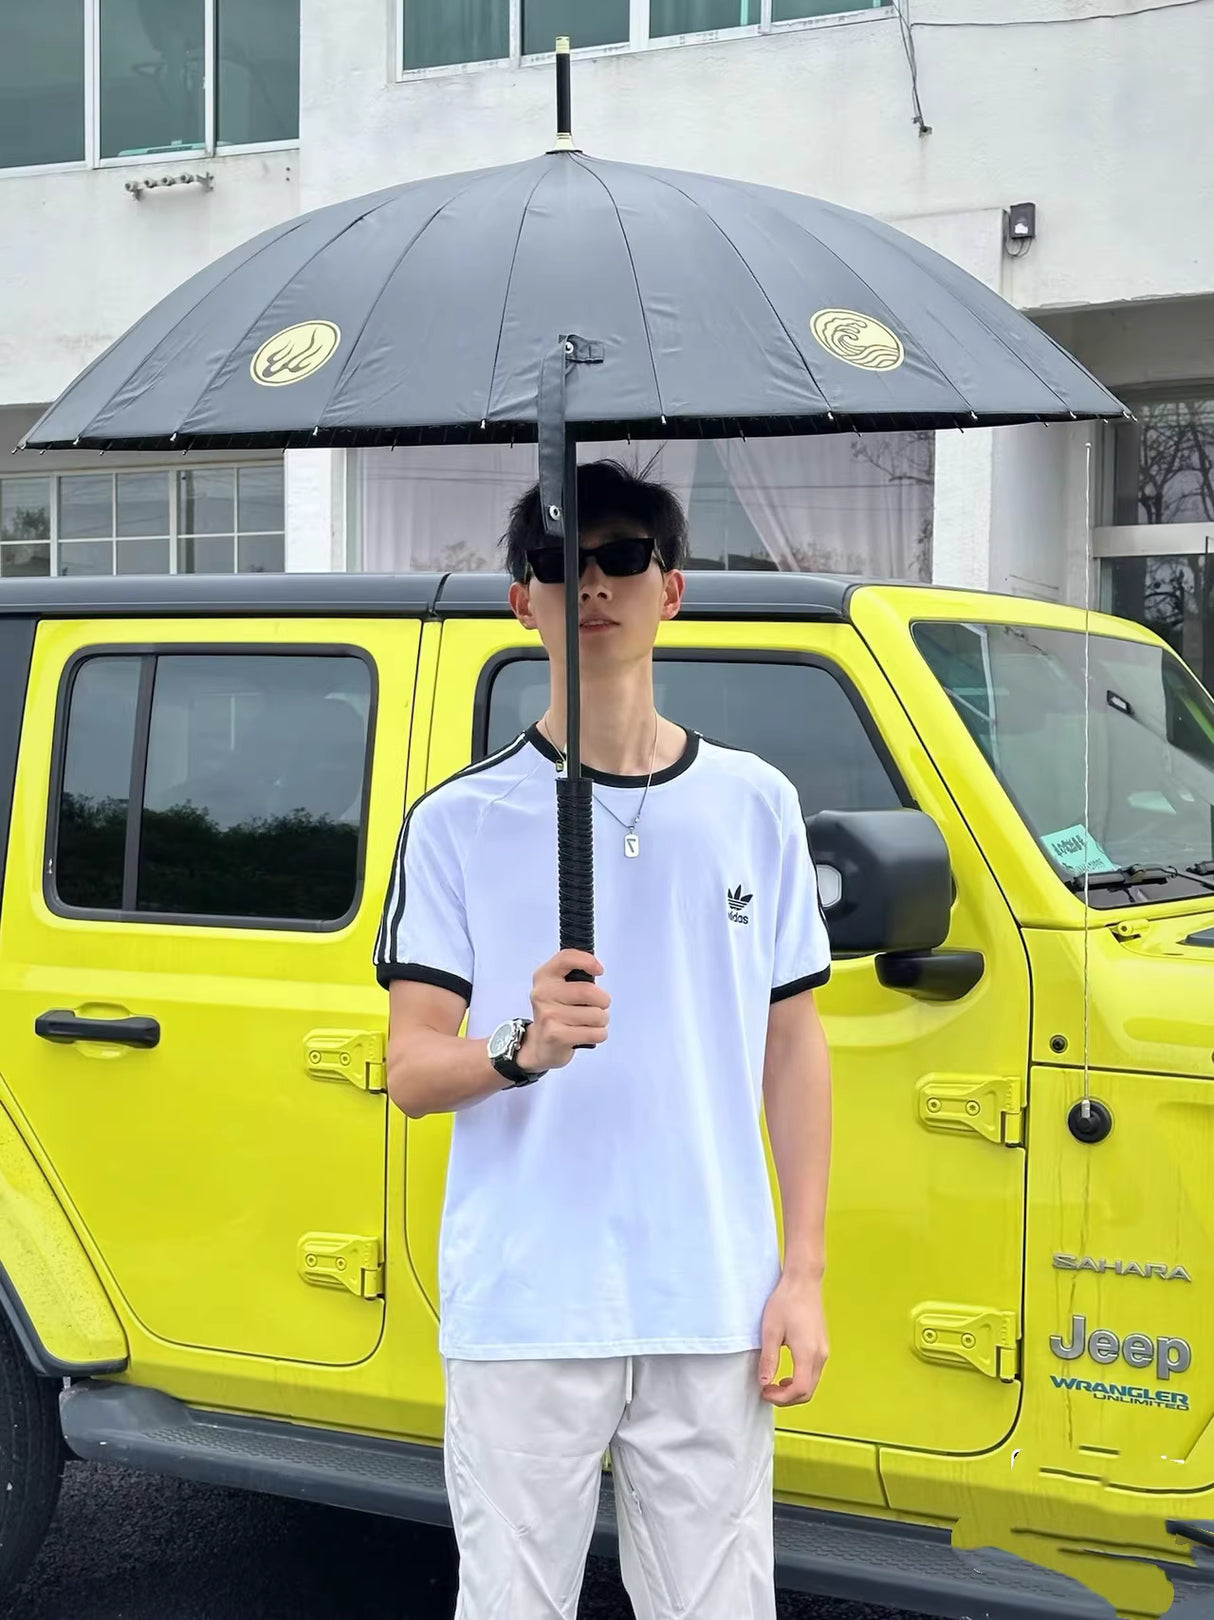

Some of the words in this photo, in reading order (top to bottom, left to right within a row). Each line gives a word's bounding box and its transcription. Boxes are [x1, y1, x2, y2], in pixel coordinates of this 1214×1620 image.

[1052, 1253, 1192, 1282] SAHARA
[1049, 1314, 1191, 1380] Jeep
[1050, 1375, 1189, 1406] WRANGLER
[1093, 1393, 1189, 1411] UNLIMITED
